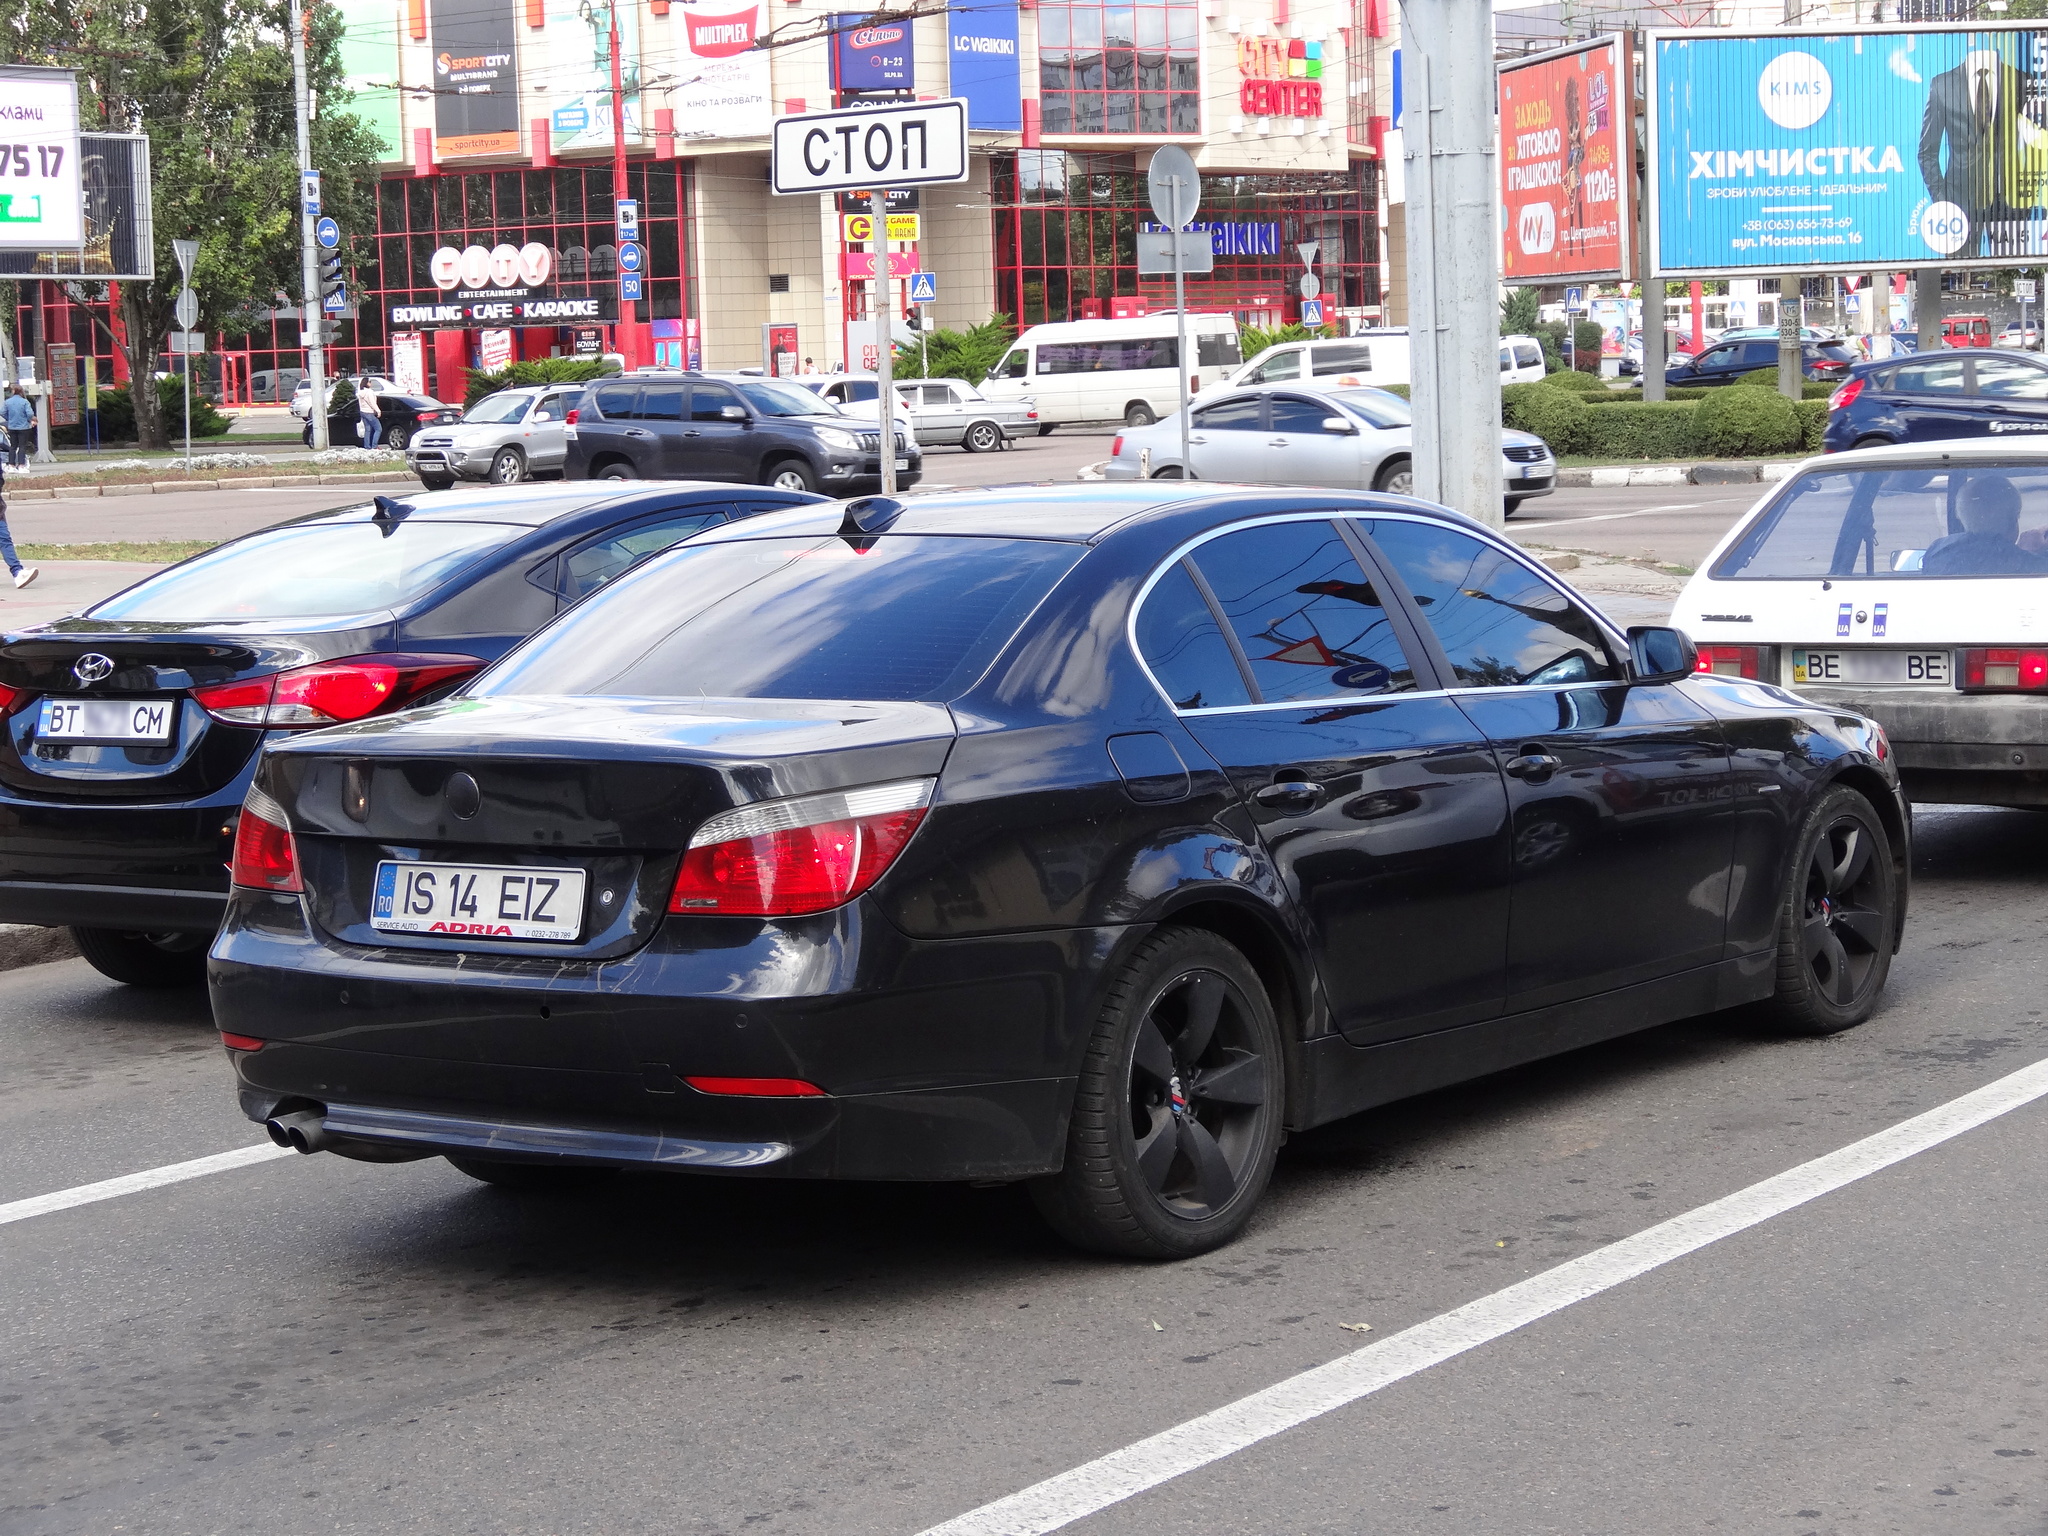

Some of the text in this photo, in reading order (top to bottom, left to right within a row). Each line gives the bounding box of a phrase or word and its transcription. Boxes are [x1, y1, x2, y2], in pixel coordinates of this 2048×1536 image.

[695, 23, 748, 46] MULTIPLEX
[954, 35, 969, 51] LC
[452, 54, 510, 70] SPORTCITY
[1238, 34, 1290, 77] CITY
[450, 70, 498, 81] MULTIBRAND
[1770, 80, 1822, 97] KIMS
[687, 100, 707, 108] КІНО
[722, 96, 762, 105] РОЗВАГИ
[1240, 79, 1322, 117] CENTER
[595, 106, 633, 126] KIA
[1515, 99, 1551, 129] ЗАХОДЬ
[454, 138, 500, 150] sportcity.ua
[803, 119, 927, 177] СТОП
[1517, 128, 1561, 160] ХІТОВОЮ
[37, 145, 64, 178] 17
[1689, 145, 1905, 179] ХІМЧИСТКА
[1508, 159, 1562, 191] ІГРАШКОЮ!
[857, 190, 910, 199] SPTCITY
[1707, 187, 1746, 199] ЗРОБИ
[1749, 185, 1811, 197] УЛЮБЛЕНЕ
[1820, 183, 1887, 196] ІДЕАЛЬНИМ
[1742, 217, 1852, 232] +38 (063) 656-73-69
[1927, 217, 1963, 236] 160
[1732, 231, 1862, 251] вул. Московська, 16
[458, 289, 528, 299] ENTERTAINMENT
[625, 280, 638, 293] 50
[393, 300, 599, 323] BOWLING CAFE KARAOKE
[1838, 624, 1849, 633] UA
[1874, 624, 1885, 634] UA
[1795, 670, 1806, 678] UA
[1808, 654, 1942, 680] BE BE
[50, 705, 165, 734] BT CM
[378, 896, 392, 912] RO
[403, 870, 560, 923] IS 14 EIZ
[376, 921, 418, 931] SERVICE AUTO
[429, 921, 514, 936] ADRIA
[560, 931, 571, 939] 789
